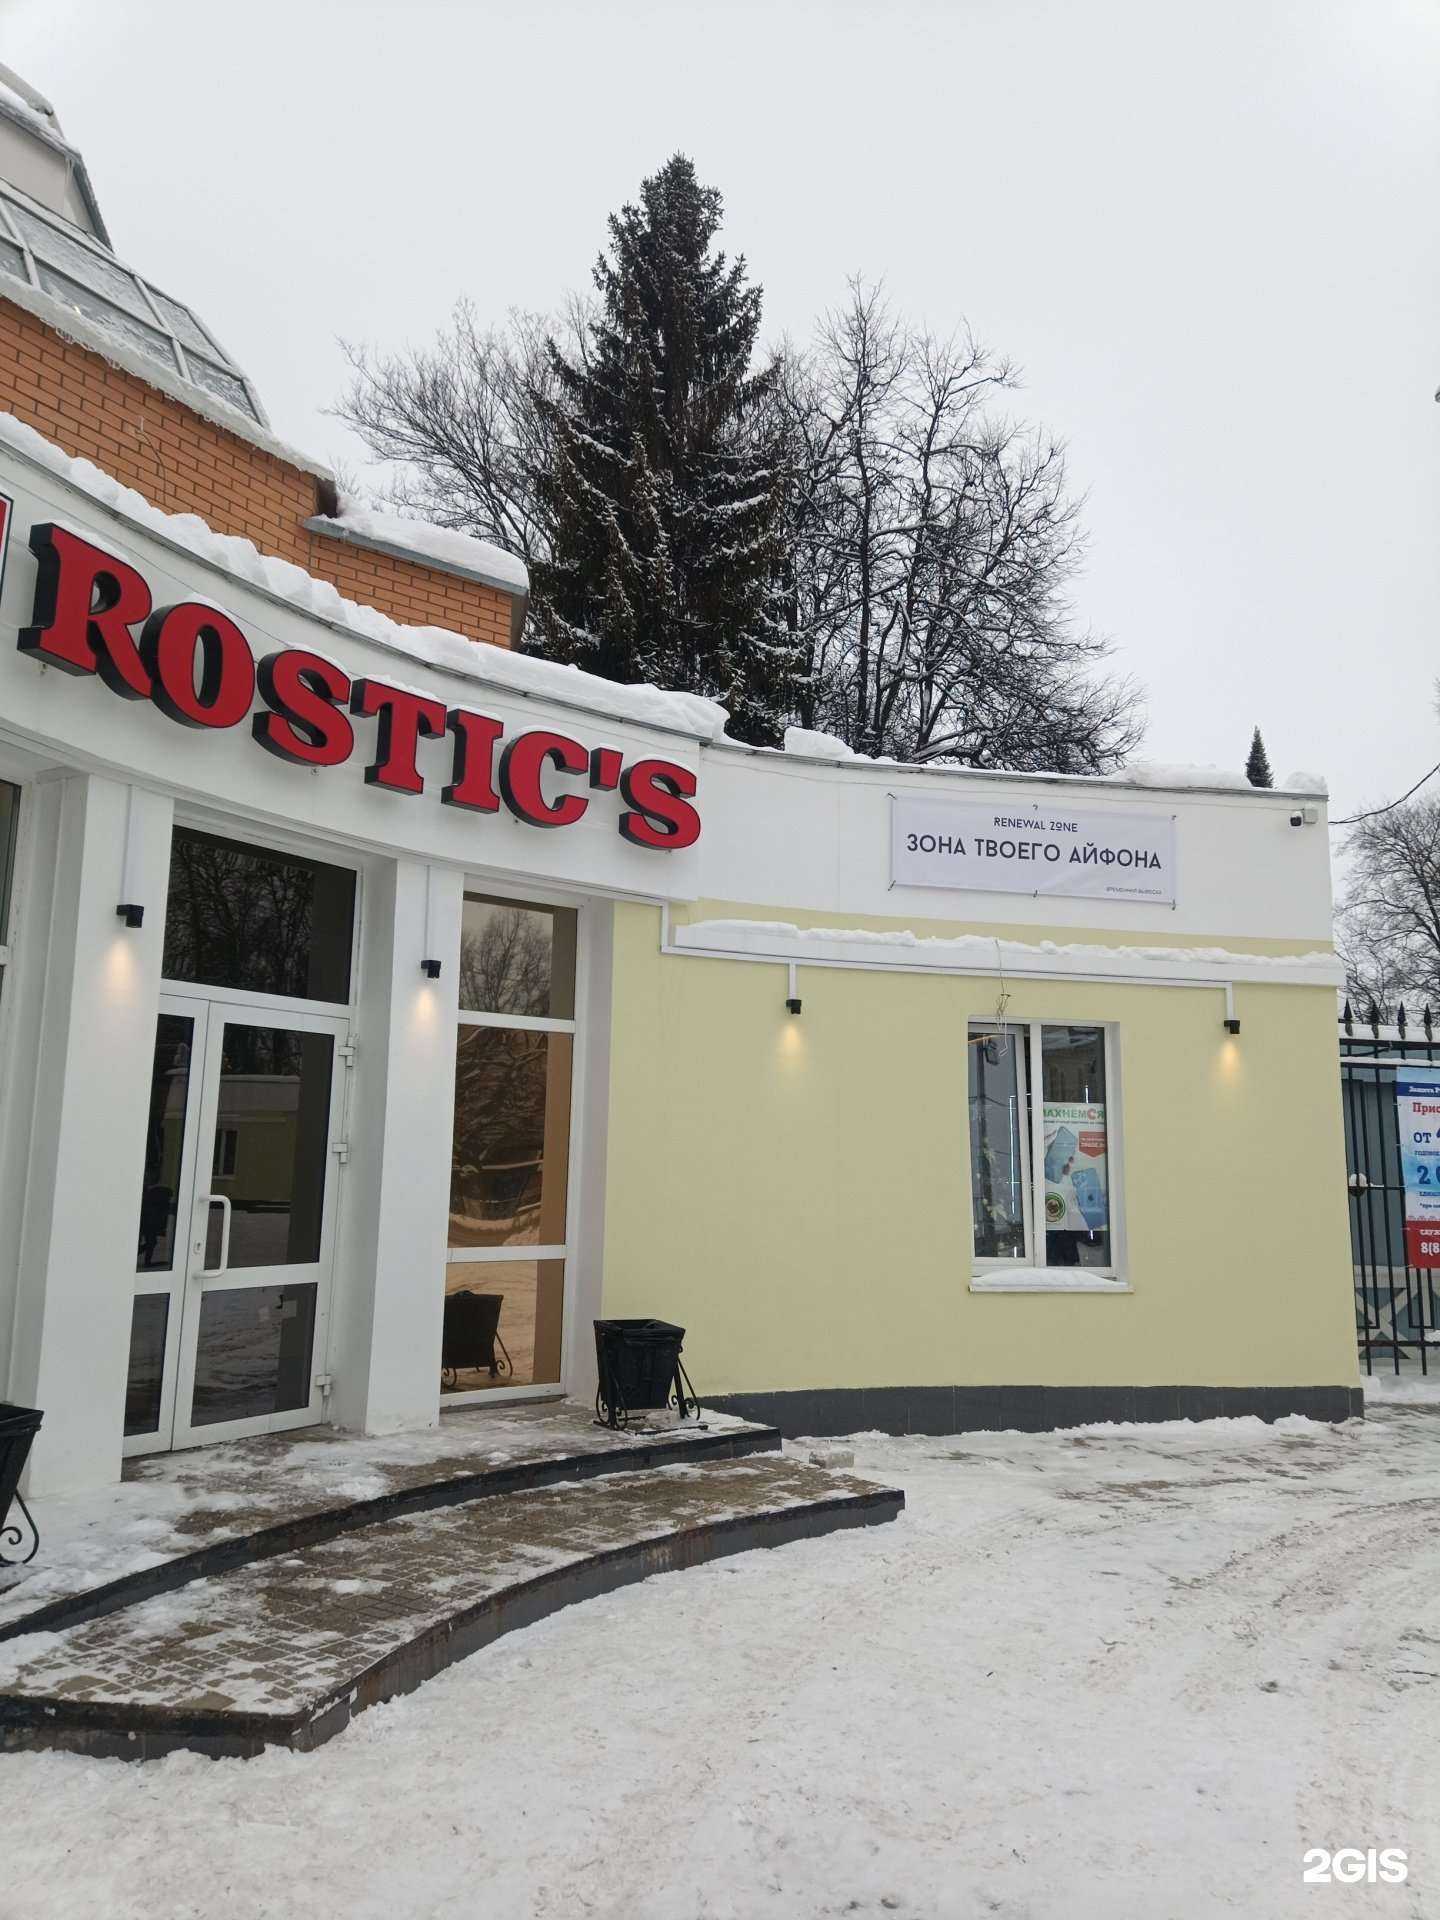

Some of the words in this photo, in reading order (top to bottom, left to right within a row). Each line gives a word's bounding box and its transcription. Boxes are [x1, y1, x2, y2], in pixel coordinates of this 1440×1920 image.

[17, 521, 702, 850] ROSTIC'S
[993, 817, 1046, 831] RENEWAL
[907, 833, 966, 856] ЗОНА
[974, 838, 1060, 862] ТВОЕГО
[1069, 842, 1162, 869] АЙФОНА
